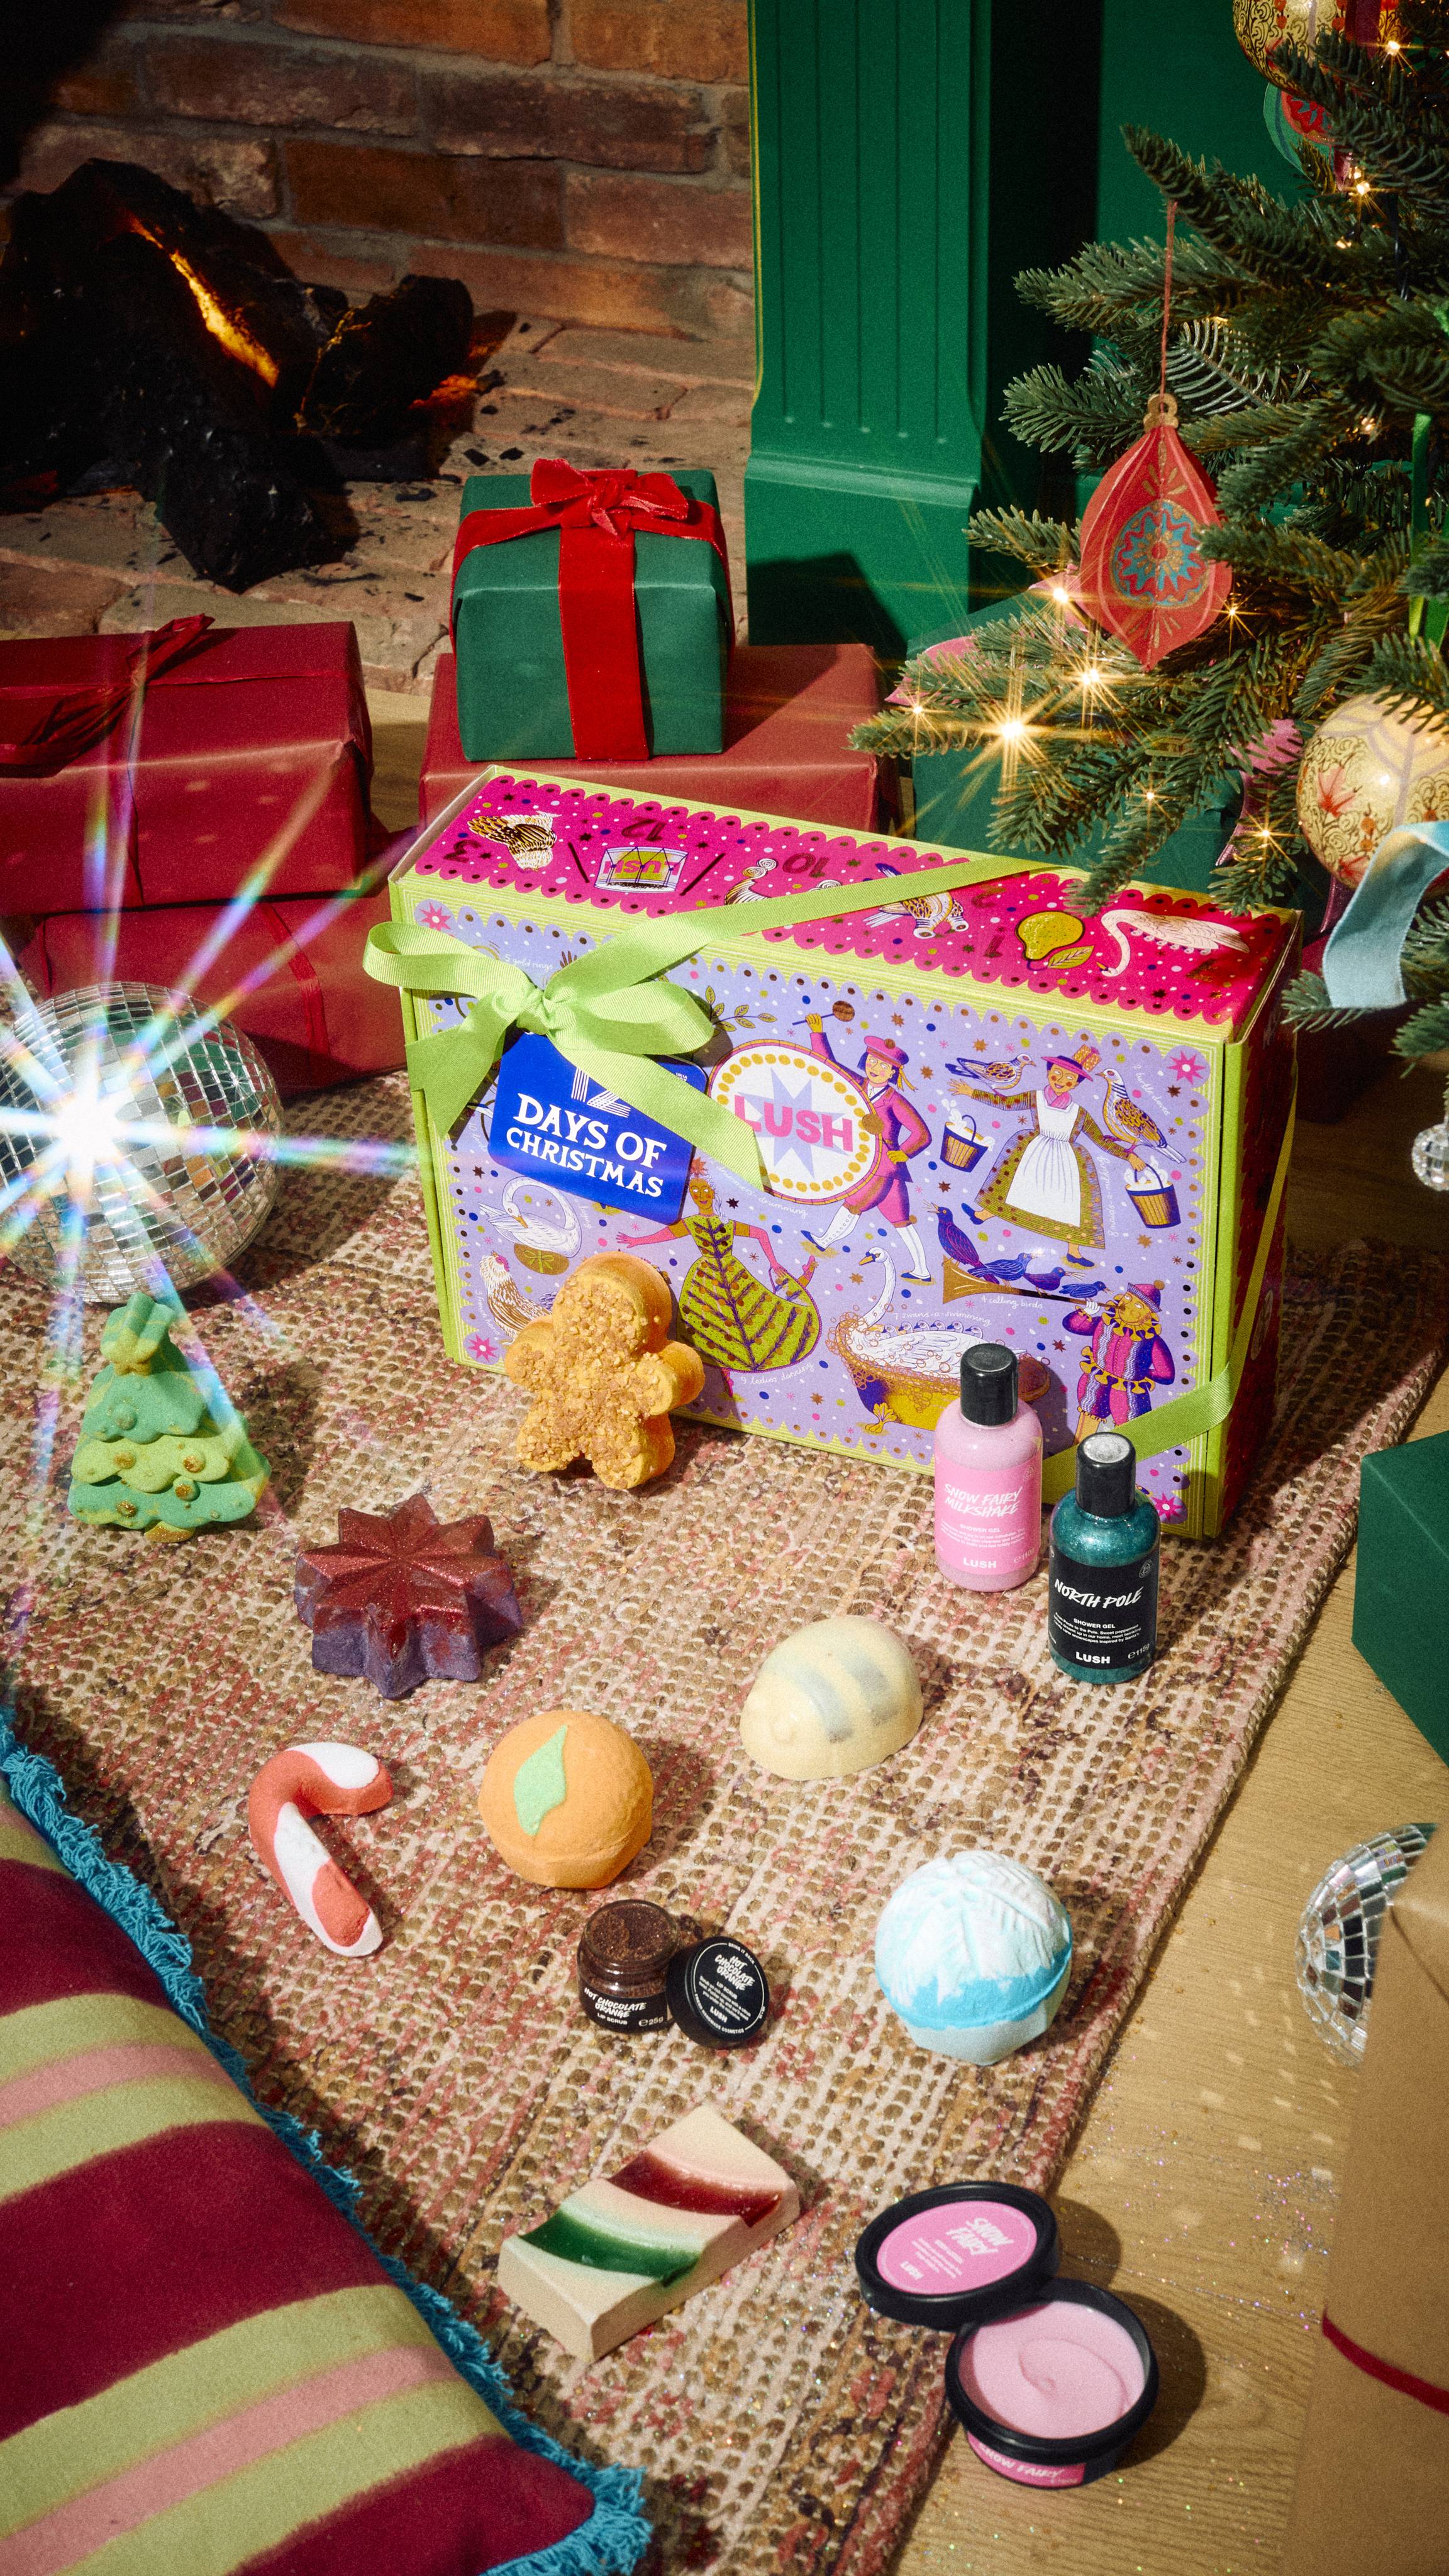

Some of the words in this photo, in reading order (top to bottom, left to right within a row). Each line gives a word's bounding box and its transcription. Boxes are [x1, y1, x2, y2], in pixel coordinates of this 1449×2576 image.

[602, 858, 680, 875] LUSH
[782, 852, 830, 878] 10
[513, 1093, 609, 1150] DAYS
[616, 1132, 667, 1169] OF
[735, 1094, 853, 1153] LUSH
[506, 1127, 663, 1197] CHRISTMAS
[981, 1295, 987, 1303] 4
[989, 1296, 1019, 1309] calling
[1021, 1299, 1043, 1309] birds
[944, 1484, 980, 1504] SNOW
[982, 1485, 1023, 1506] FAIRY
[945, 1496, 1021, 1518] MILKSHAKE
[960, 1523, 987, 1533] SHOWER
[962, 1557, 997, 1568] LUSH
[1054, 1579, 1101, 1608] NORTH
[1102, 1586, 1144, 1609] POLE
[1073, 1618, 1101, 1629] SHOWER
[1075, 1651, 1111, 1664] LUSH
[714, 1953, 755, 1987] CHOCOLATE
[730, 1955, 748, 1970] HOT
[716, 1965, 747, 1991] ORANGE
[584, 1987, 599, 2001] HOT
[597, 1997, 647, 2011] CHOCOLATE
[723, 1985, 738, 2000] SCRUB
[594, 2002, 631, 2019] ORANGE
[709, 2005, 728, 2023] LUSH
[606, 2016, 628, 2026] SCRUB
[721, 2026, 745, 2035] COSMETICS
[965, 2217, 1014, 2246] SNOW
[945, 2227, 999, 2256] FAIRY
[899, 2260, 924, 2280] LUSH
[1016, 2464, 1065, 2479] FAIRY
